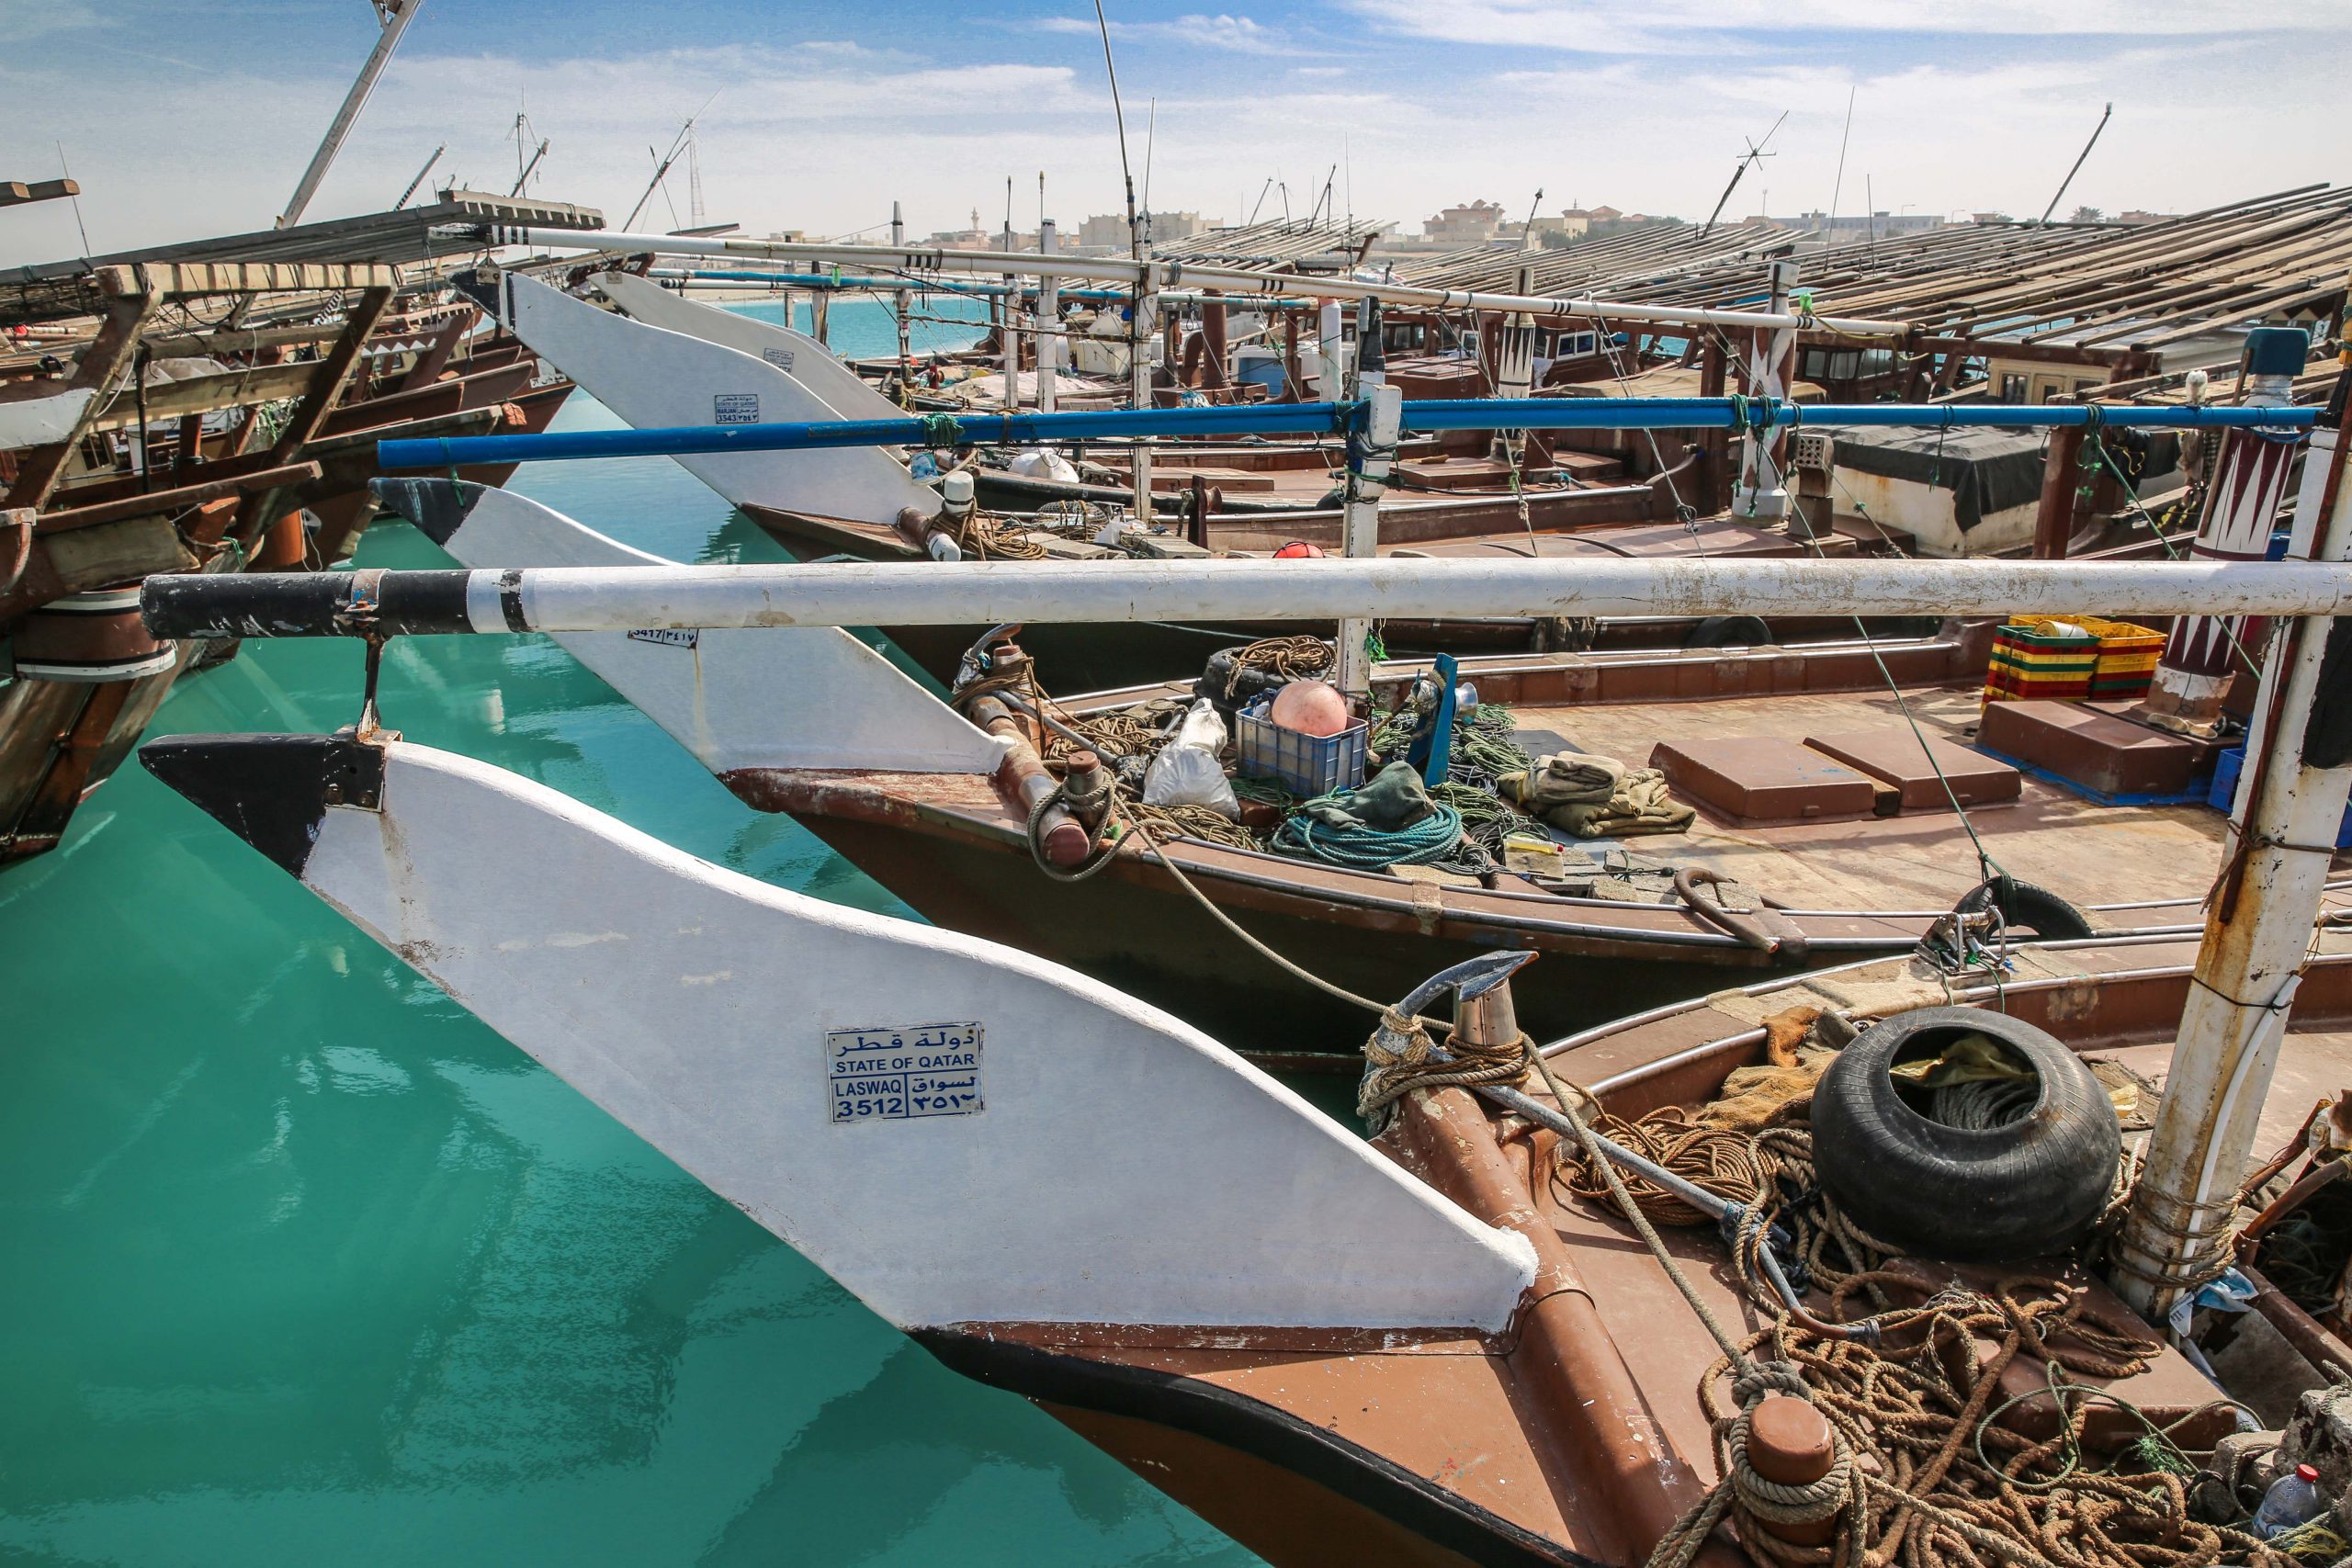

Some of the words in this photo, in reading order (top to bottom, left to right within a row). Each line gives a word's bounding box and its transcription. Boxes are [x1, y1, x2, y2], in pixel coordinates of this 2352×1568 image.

[835, 1033, 903, 1057] قطر
[914, 1031, 975, 1051] دولة
[836, 1058, 887, 1073] STATE
[891, 1057, 913, 1069] OF
[919, 1054, 975, 1068] QATAR
[835, 1079, 902, 1097] LASWAQ
[911, 1076, 976, 1093] لسواق
[837, 1097, 903, 1117] 3512
